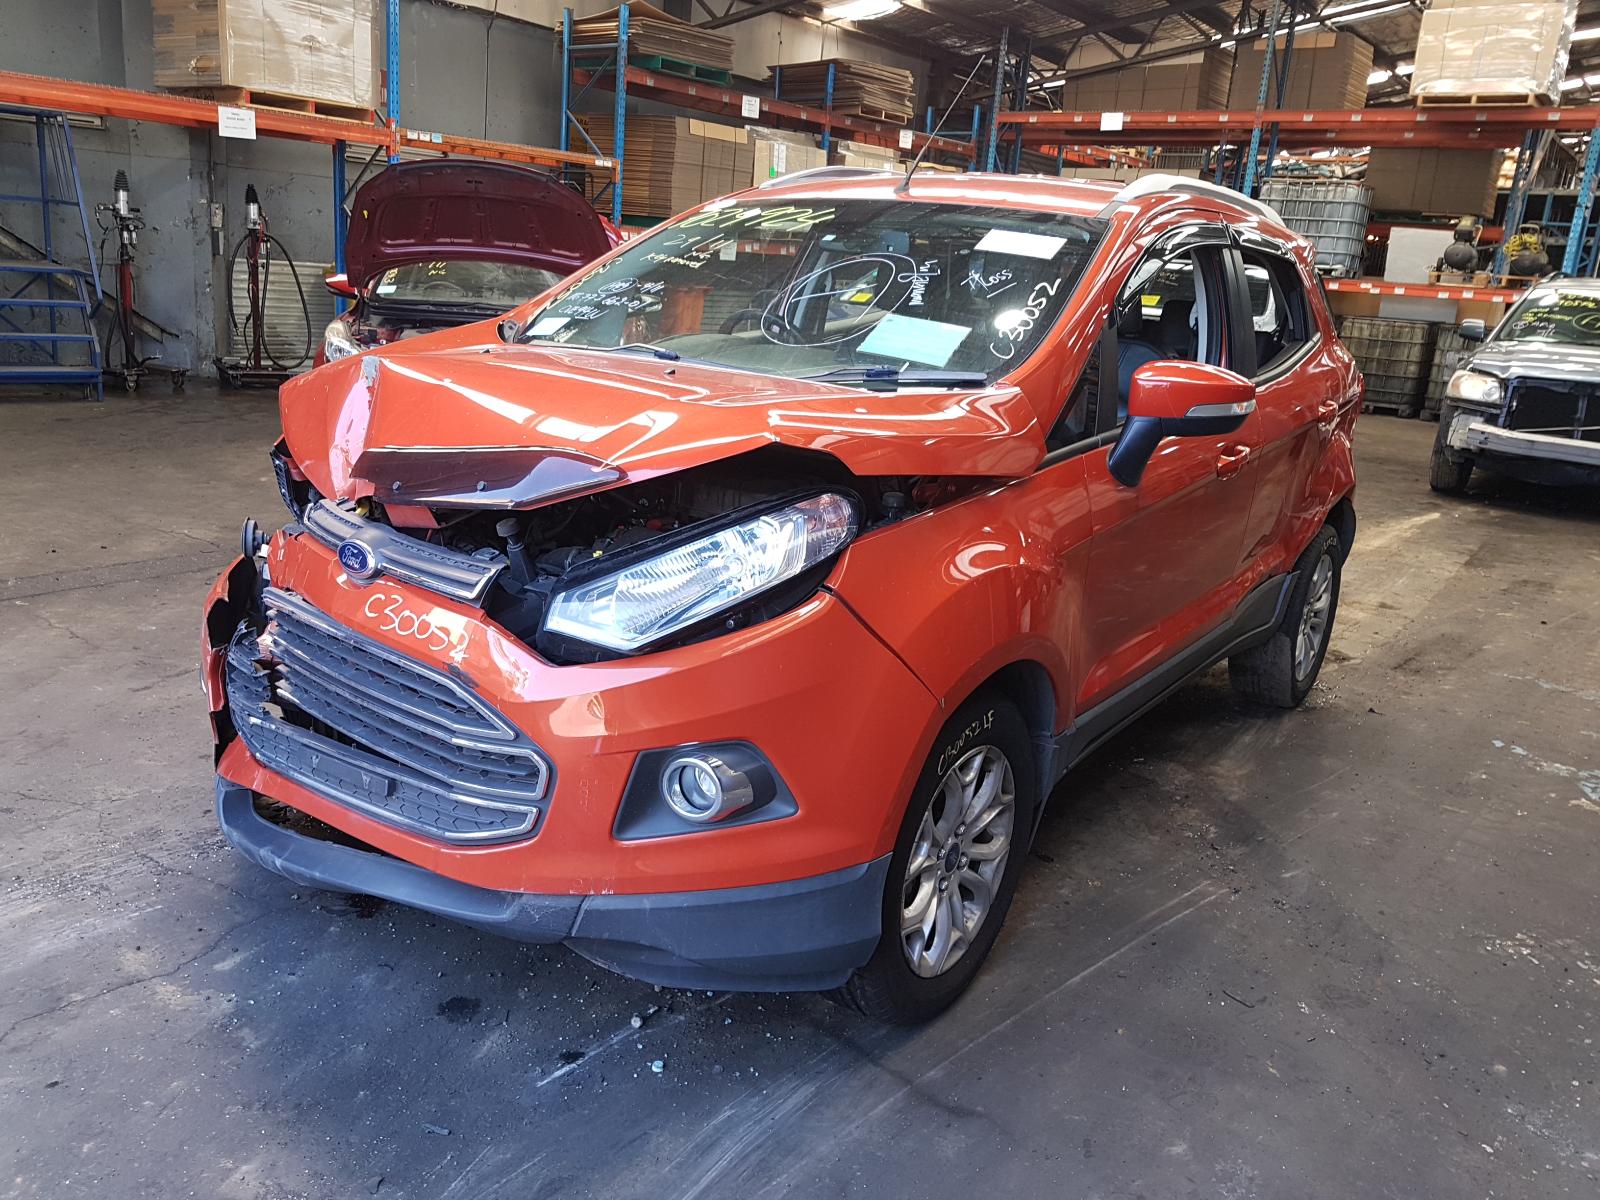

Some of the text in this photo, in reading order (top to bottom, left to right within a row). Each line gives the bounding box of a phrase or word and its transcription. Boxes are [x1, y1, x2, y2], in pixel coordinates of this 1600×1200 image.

[990, 277, 1062, 360] C30052
[341, 544, 364, 570] Ford
[364, 593, 470, 664] C30052
